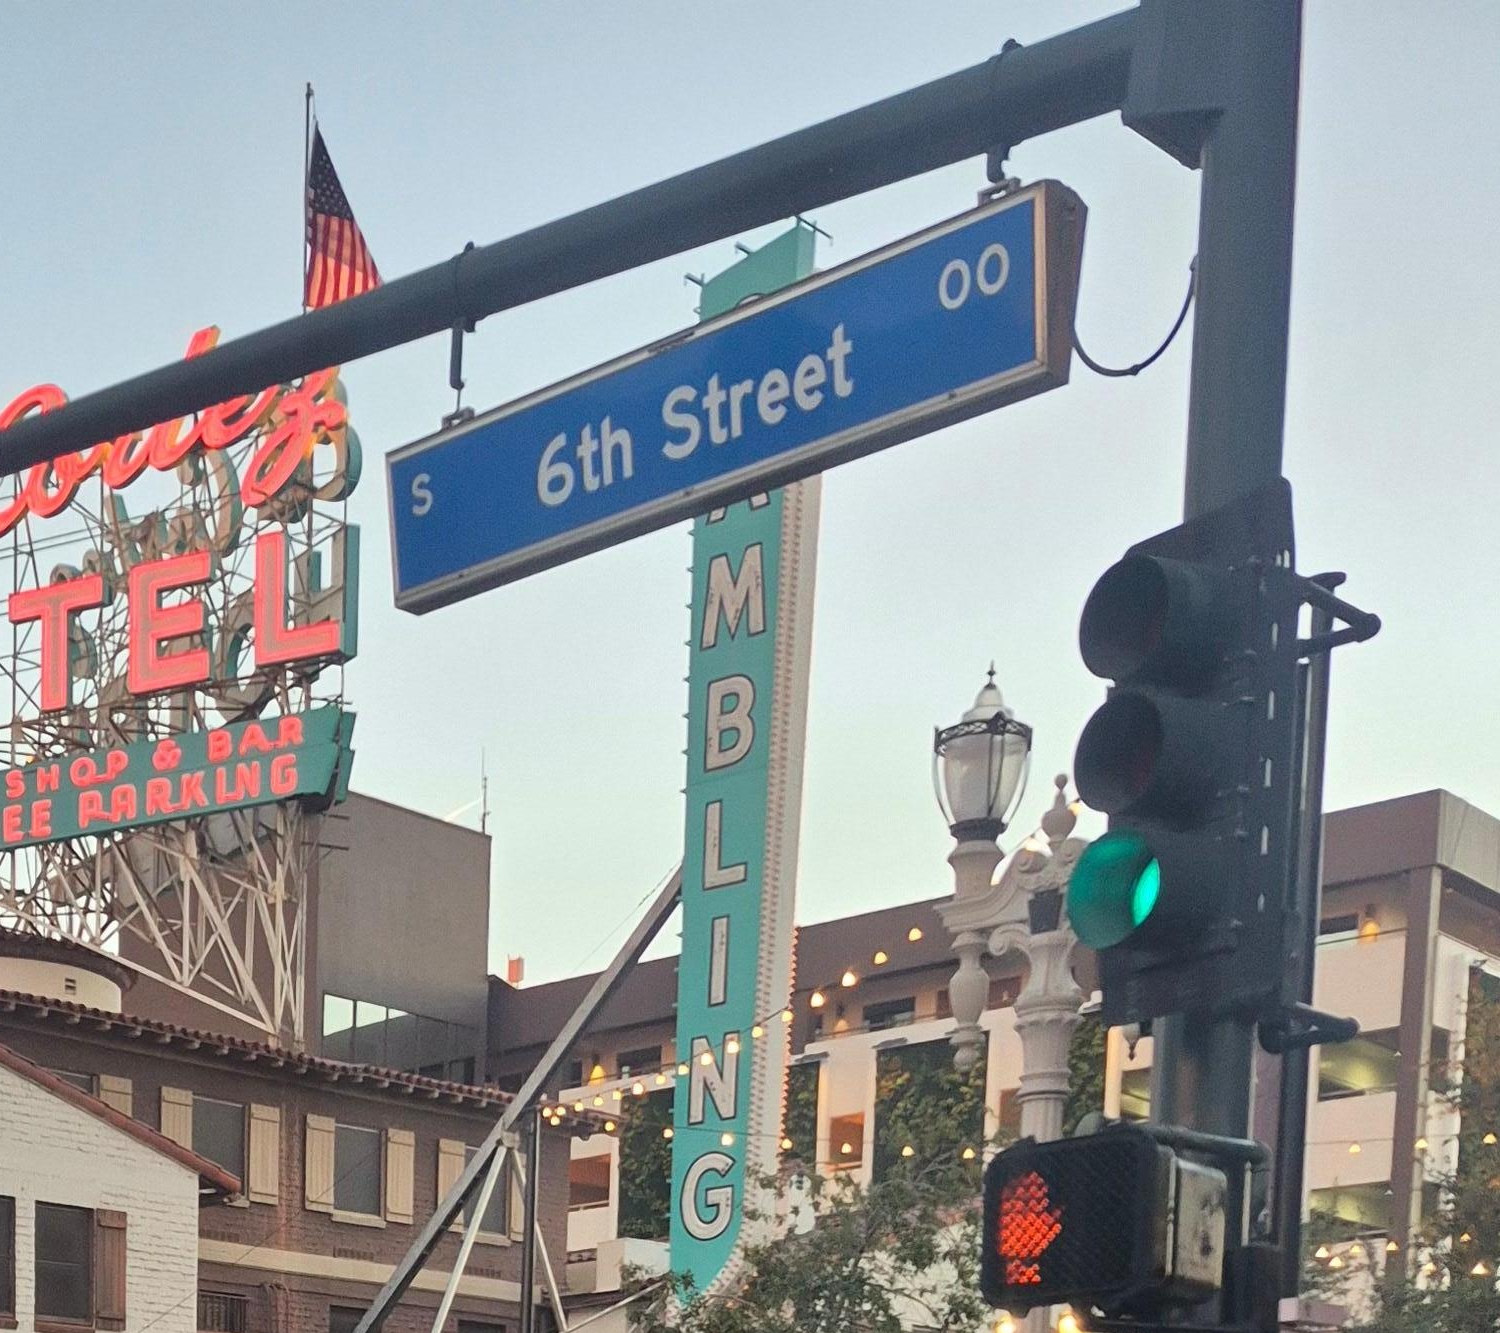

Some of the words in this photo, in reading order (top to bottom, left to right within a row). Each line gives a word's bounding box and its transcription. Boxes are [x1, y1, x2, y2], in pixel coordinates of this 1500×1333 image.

[411, 473, 433, 517] S
[537, 415, 635, 508] 6th
[661, 323, 855, 461] Street
[5, 750, 130, 799] SHOP
[151, 738, 183, 771] &
[207, 716, 305, 762] BAR
[78, 753, 298, 829] PARKING
[681, 490, 769, 1242] MBLING
